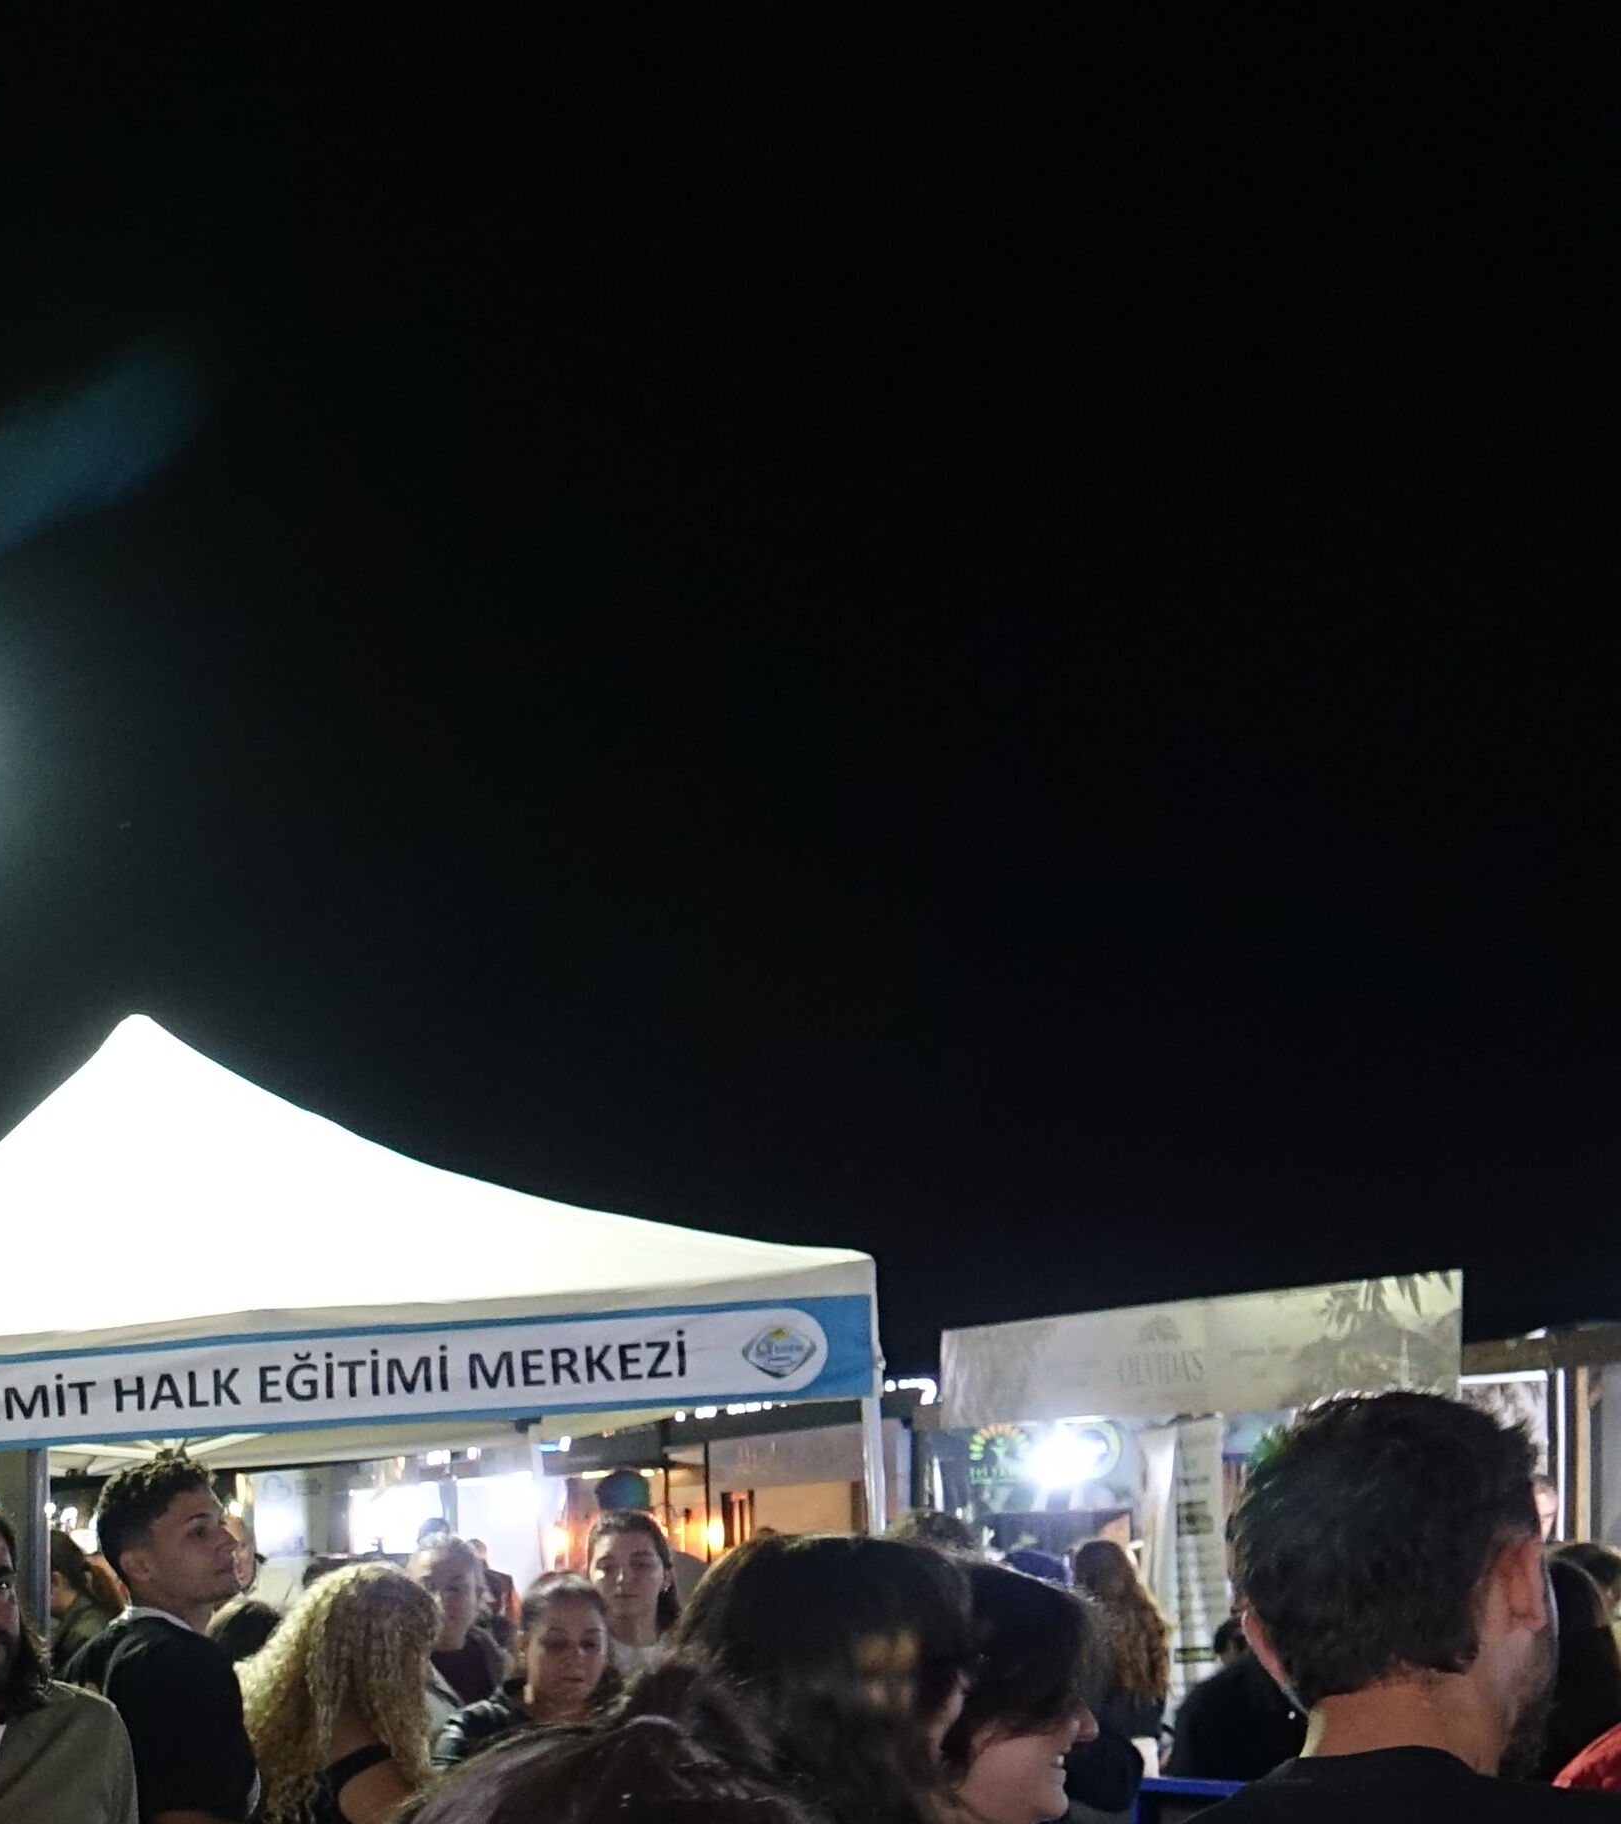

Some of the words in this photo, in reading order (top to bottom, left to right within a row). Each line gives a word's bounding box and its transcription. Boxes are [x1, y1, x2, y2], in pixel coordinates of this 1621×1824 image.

[114, 1367, 242, 1412] HALK
[259, 1344, 450, 1403] EĞİTİMİ
[469, 1329, 687, 1390] MERKEZİ
